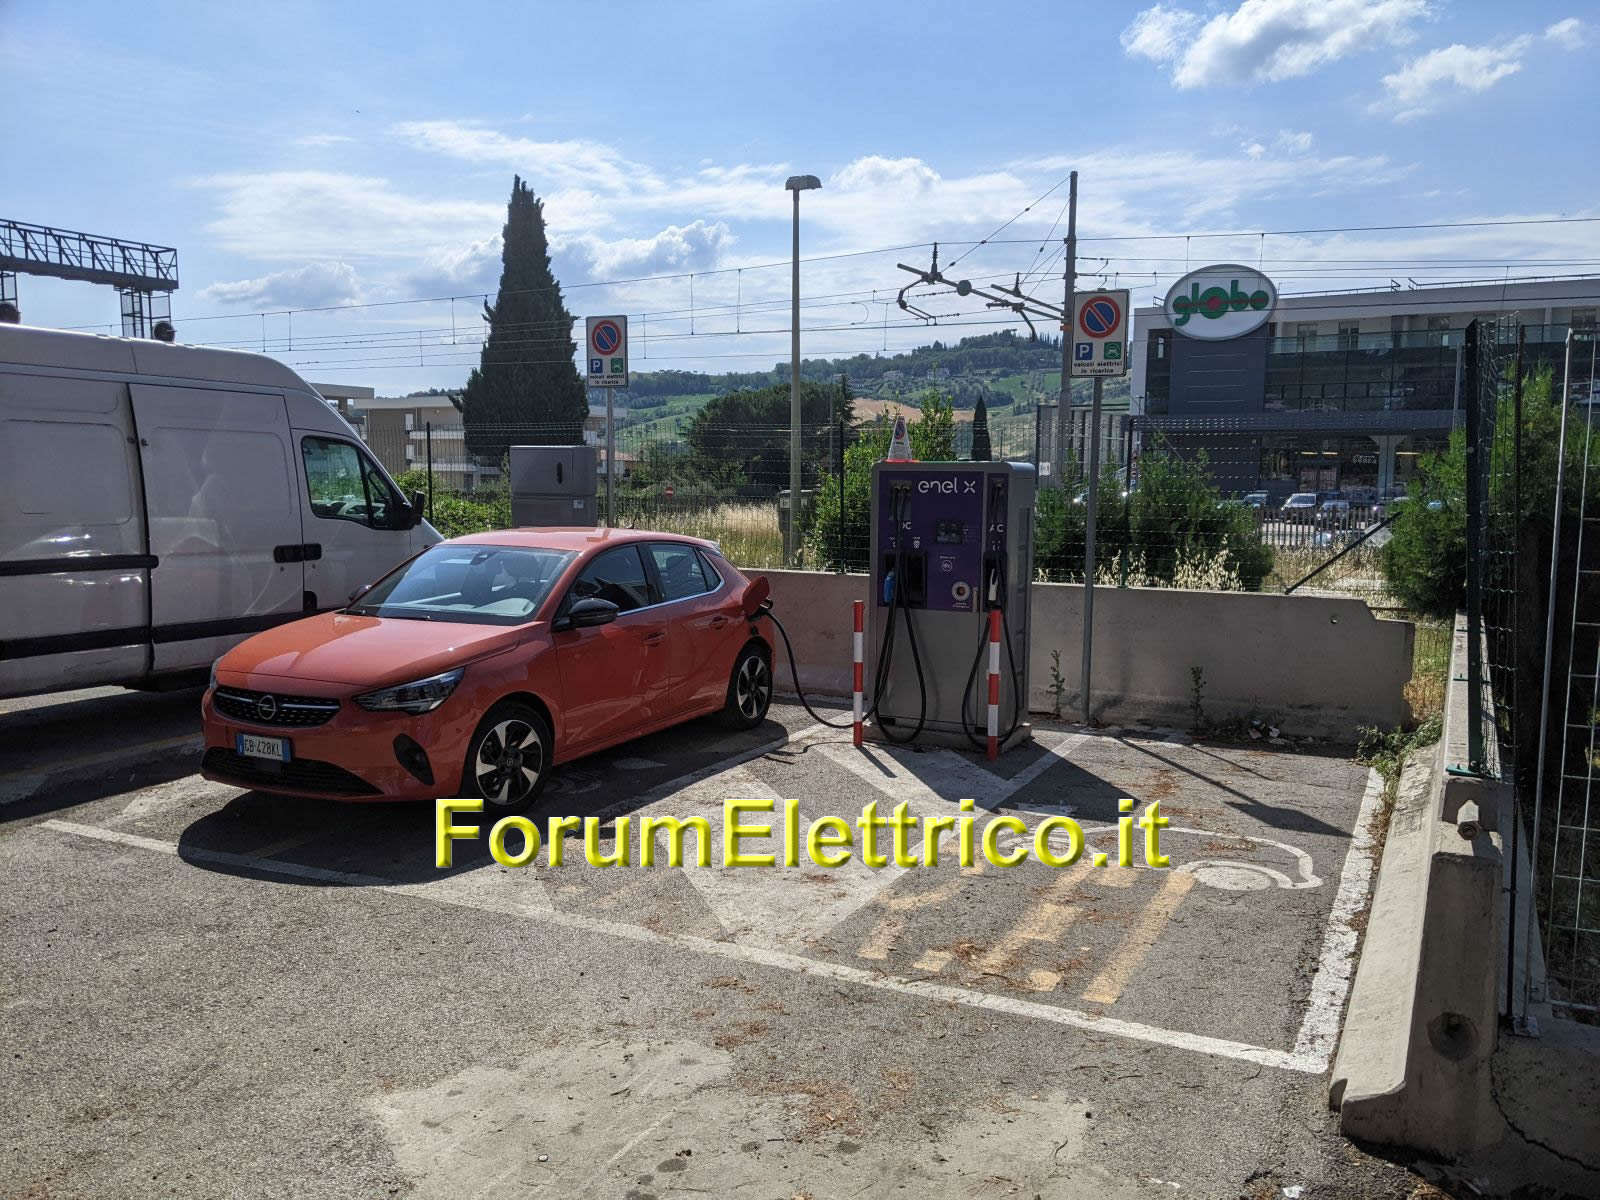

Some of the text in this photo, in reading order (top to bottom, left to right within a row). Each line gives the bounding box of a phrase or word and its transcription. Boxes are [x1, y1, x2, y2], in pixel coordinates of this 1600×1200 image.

[1172, 279, 1269, 327] globo
[1080, 344, 1090, 358] P
[592, 360, 600, 371] P
[918, 477, 958, 494] enel
